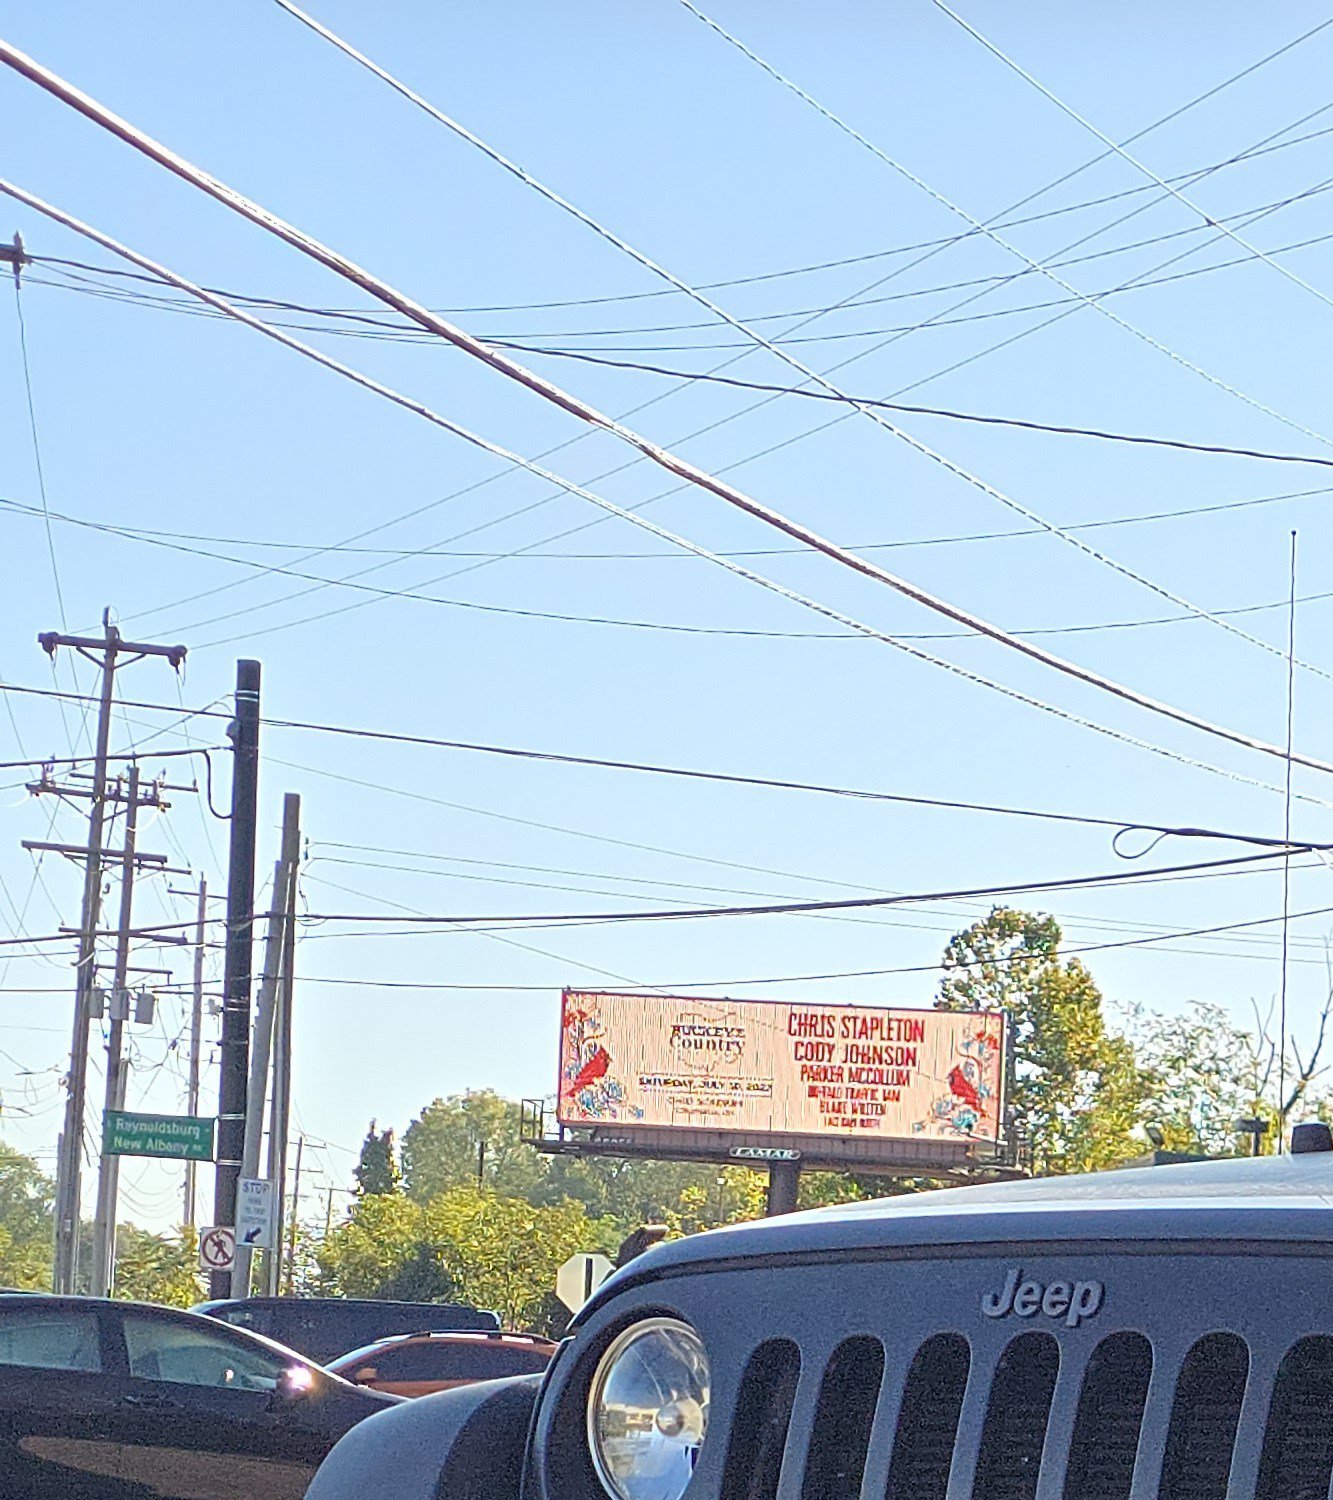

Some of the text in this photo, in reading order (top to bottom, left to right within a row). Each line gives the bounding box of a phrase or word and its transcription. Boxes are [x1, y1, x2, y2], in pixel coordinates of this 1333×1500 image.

[788, 1012, 926, 1043] CHRIS STAPLETON
[794, 1040, 918, 1067] CODY JOHNSON
[115, 1118, 200, 1140] Reynoldsburg
[114, 1136, 141, 1149] New
[145, 1138, 189, 1155] Albany
[735, 1148, 794, 1159] LAMAR
[982, 1269, 1104, 1327] Jeep
